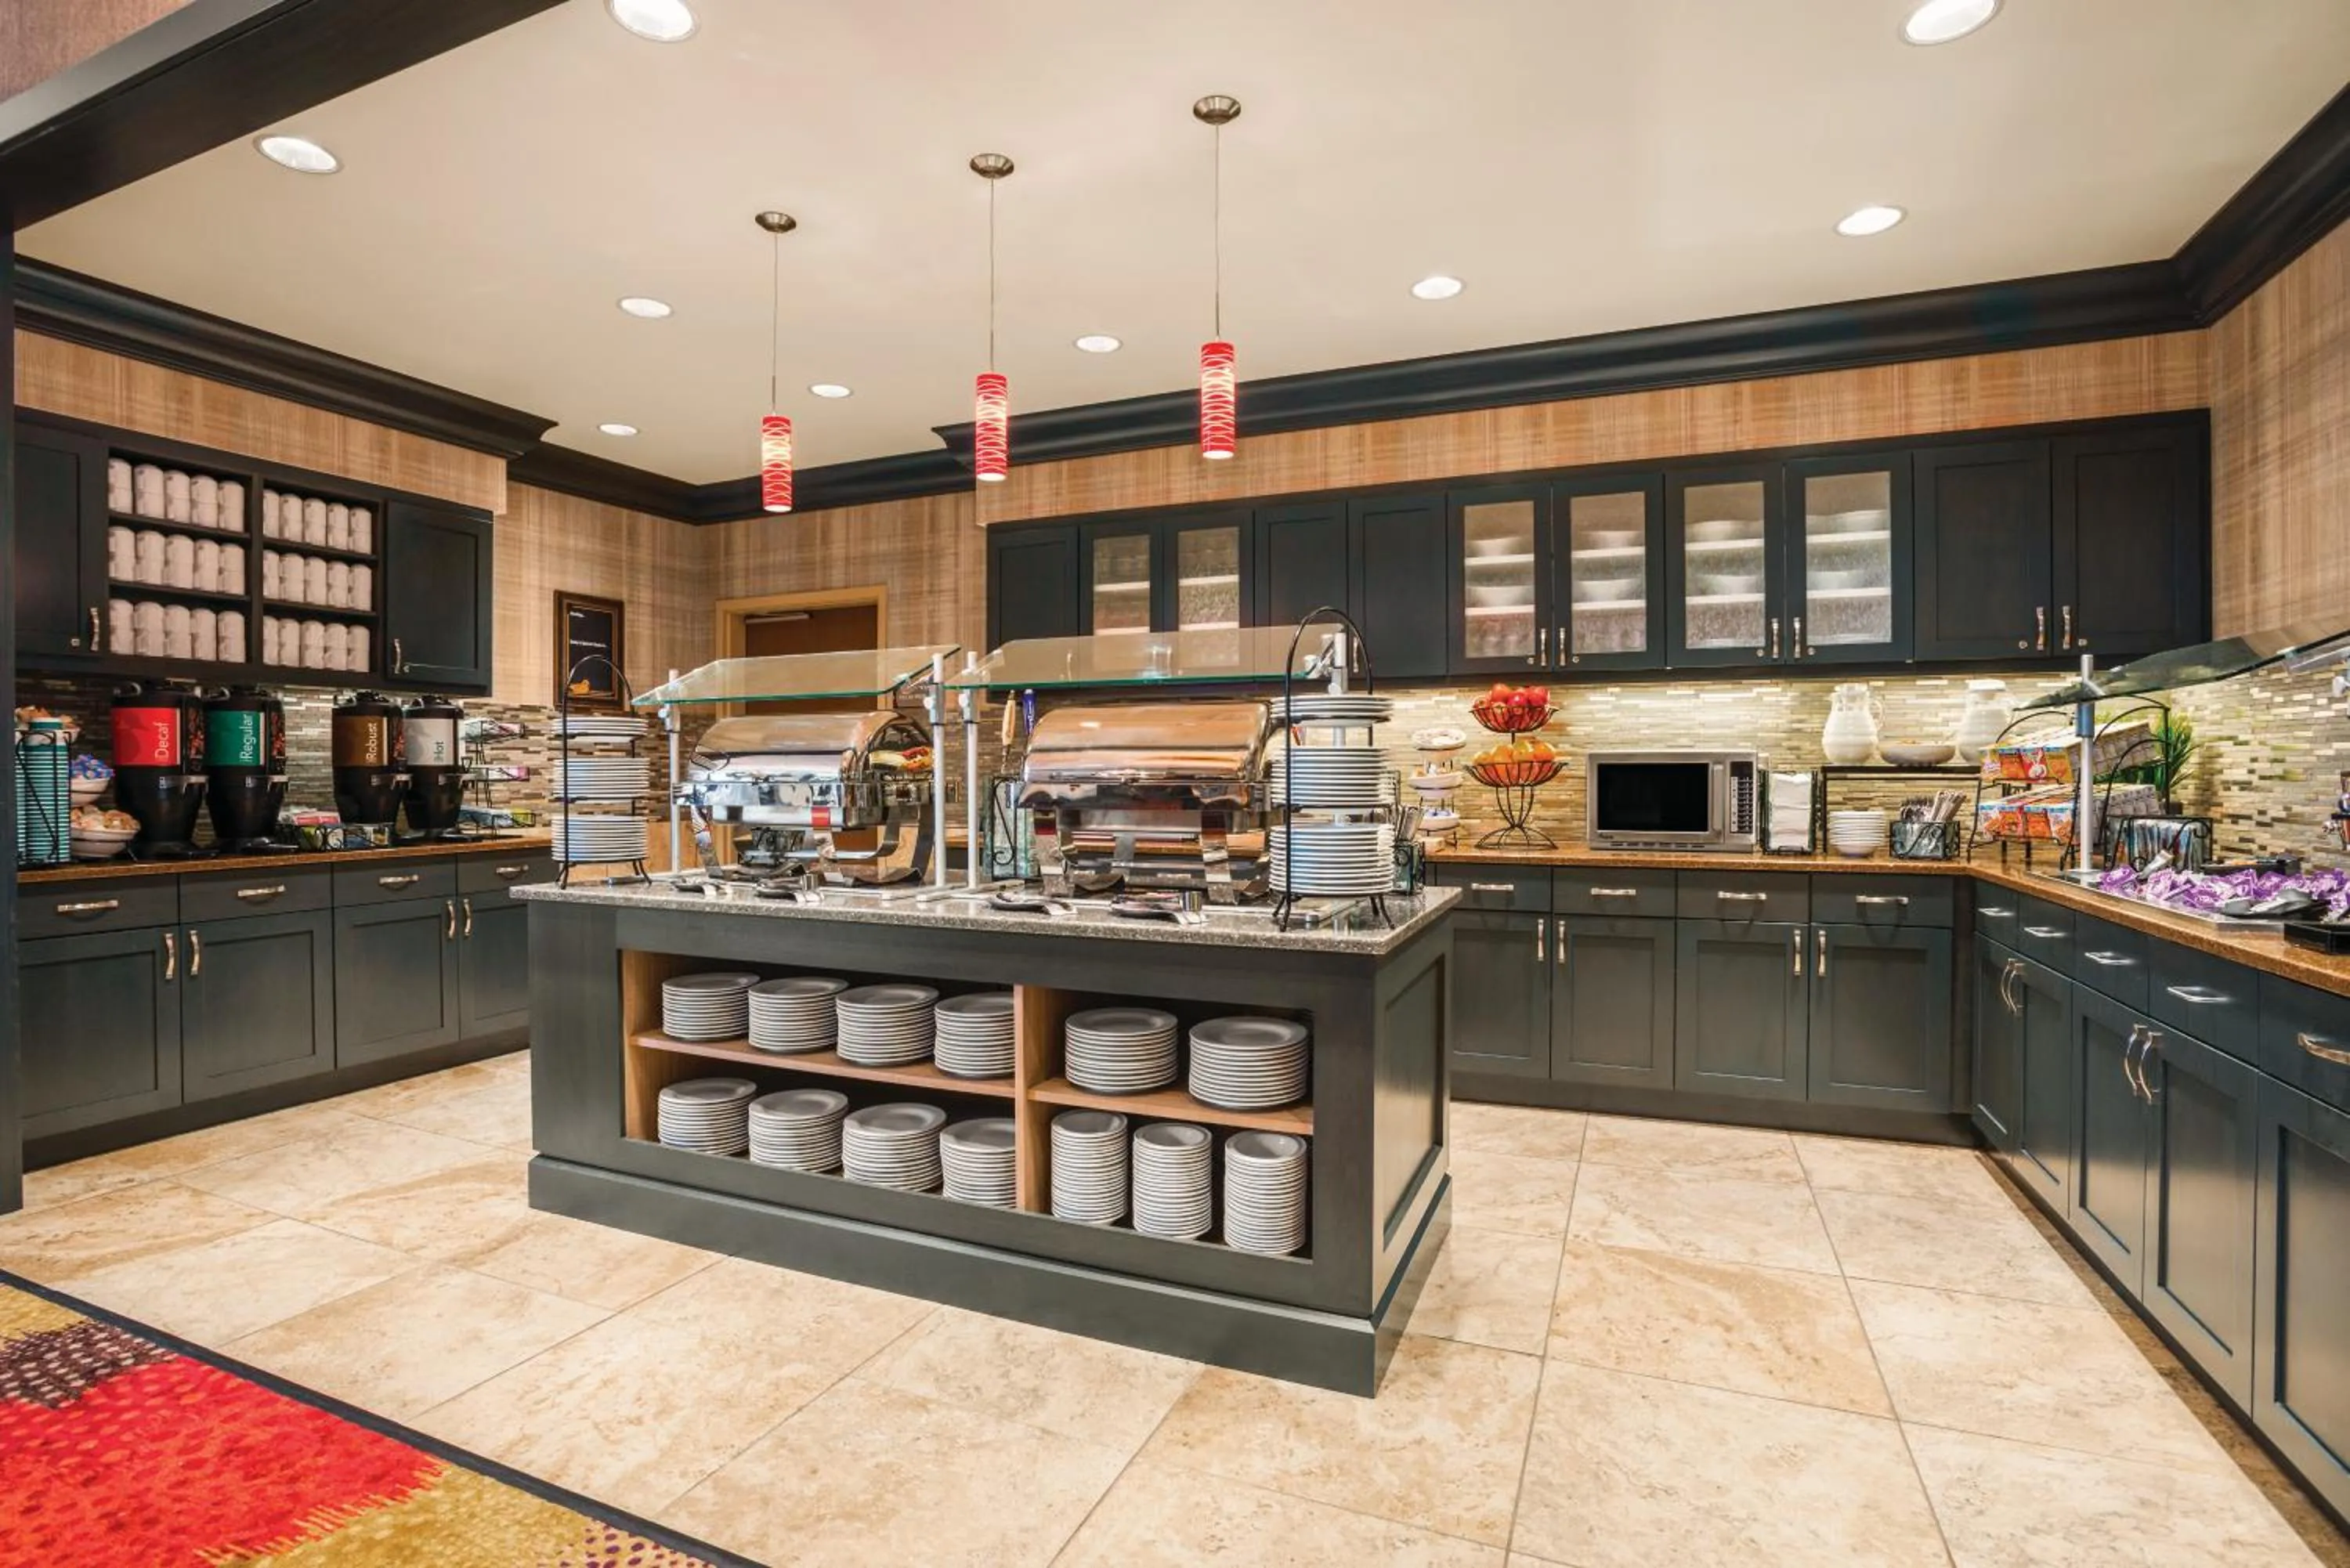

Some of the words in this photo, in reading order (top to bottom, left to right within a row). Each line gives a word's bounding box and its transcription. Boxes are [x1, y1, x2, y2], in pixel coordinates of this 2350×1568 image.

[153, 721, 169, 760] Decaf
[239, 714, 257, 759] Regular
[365, 722, 378, 761] Robust
